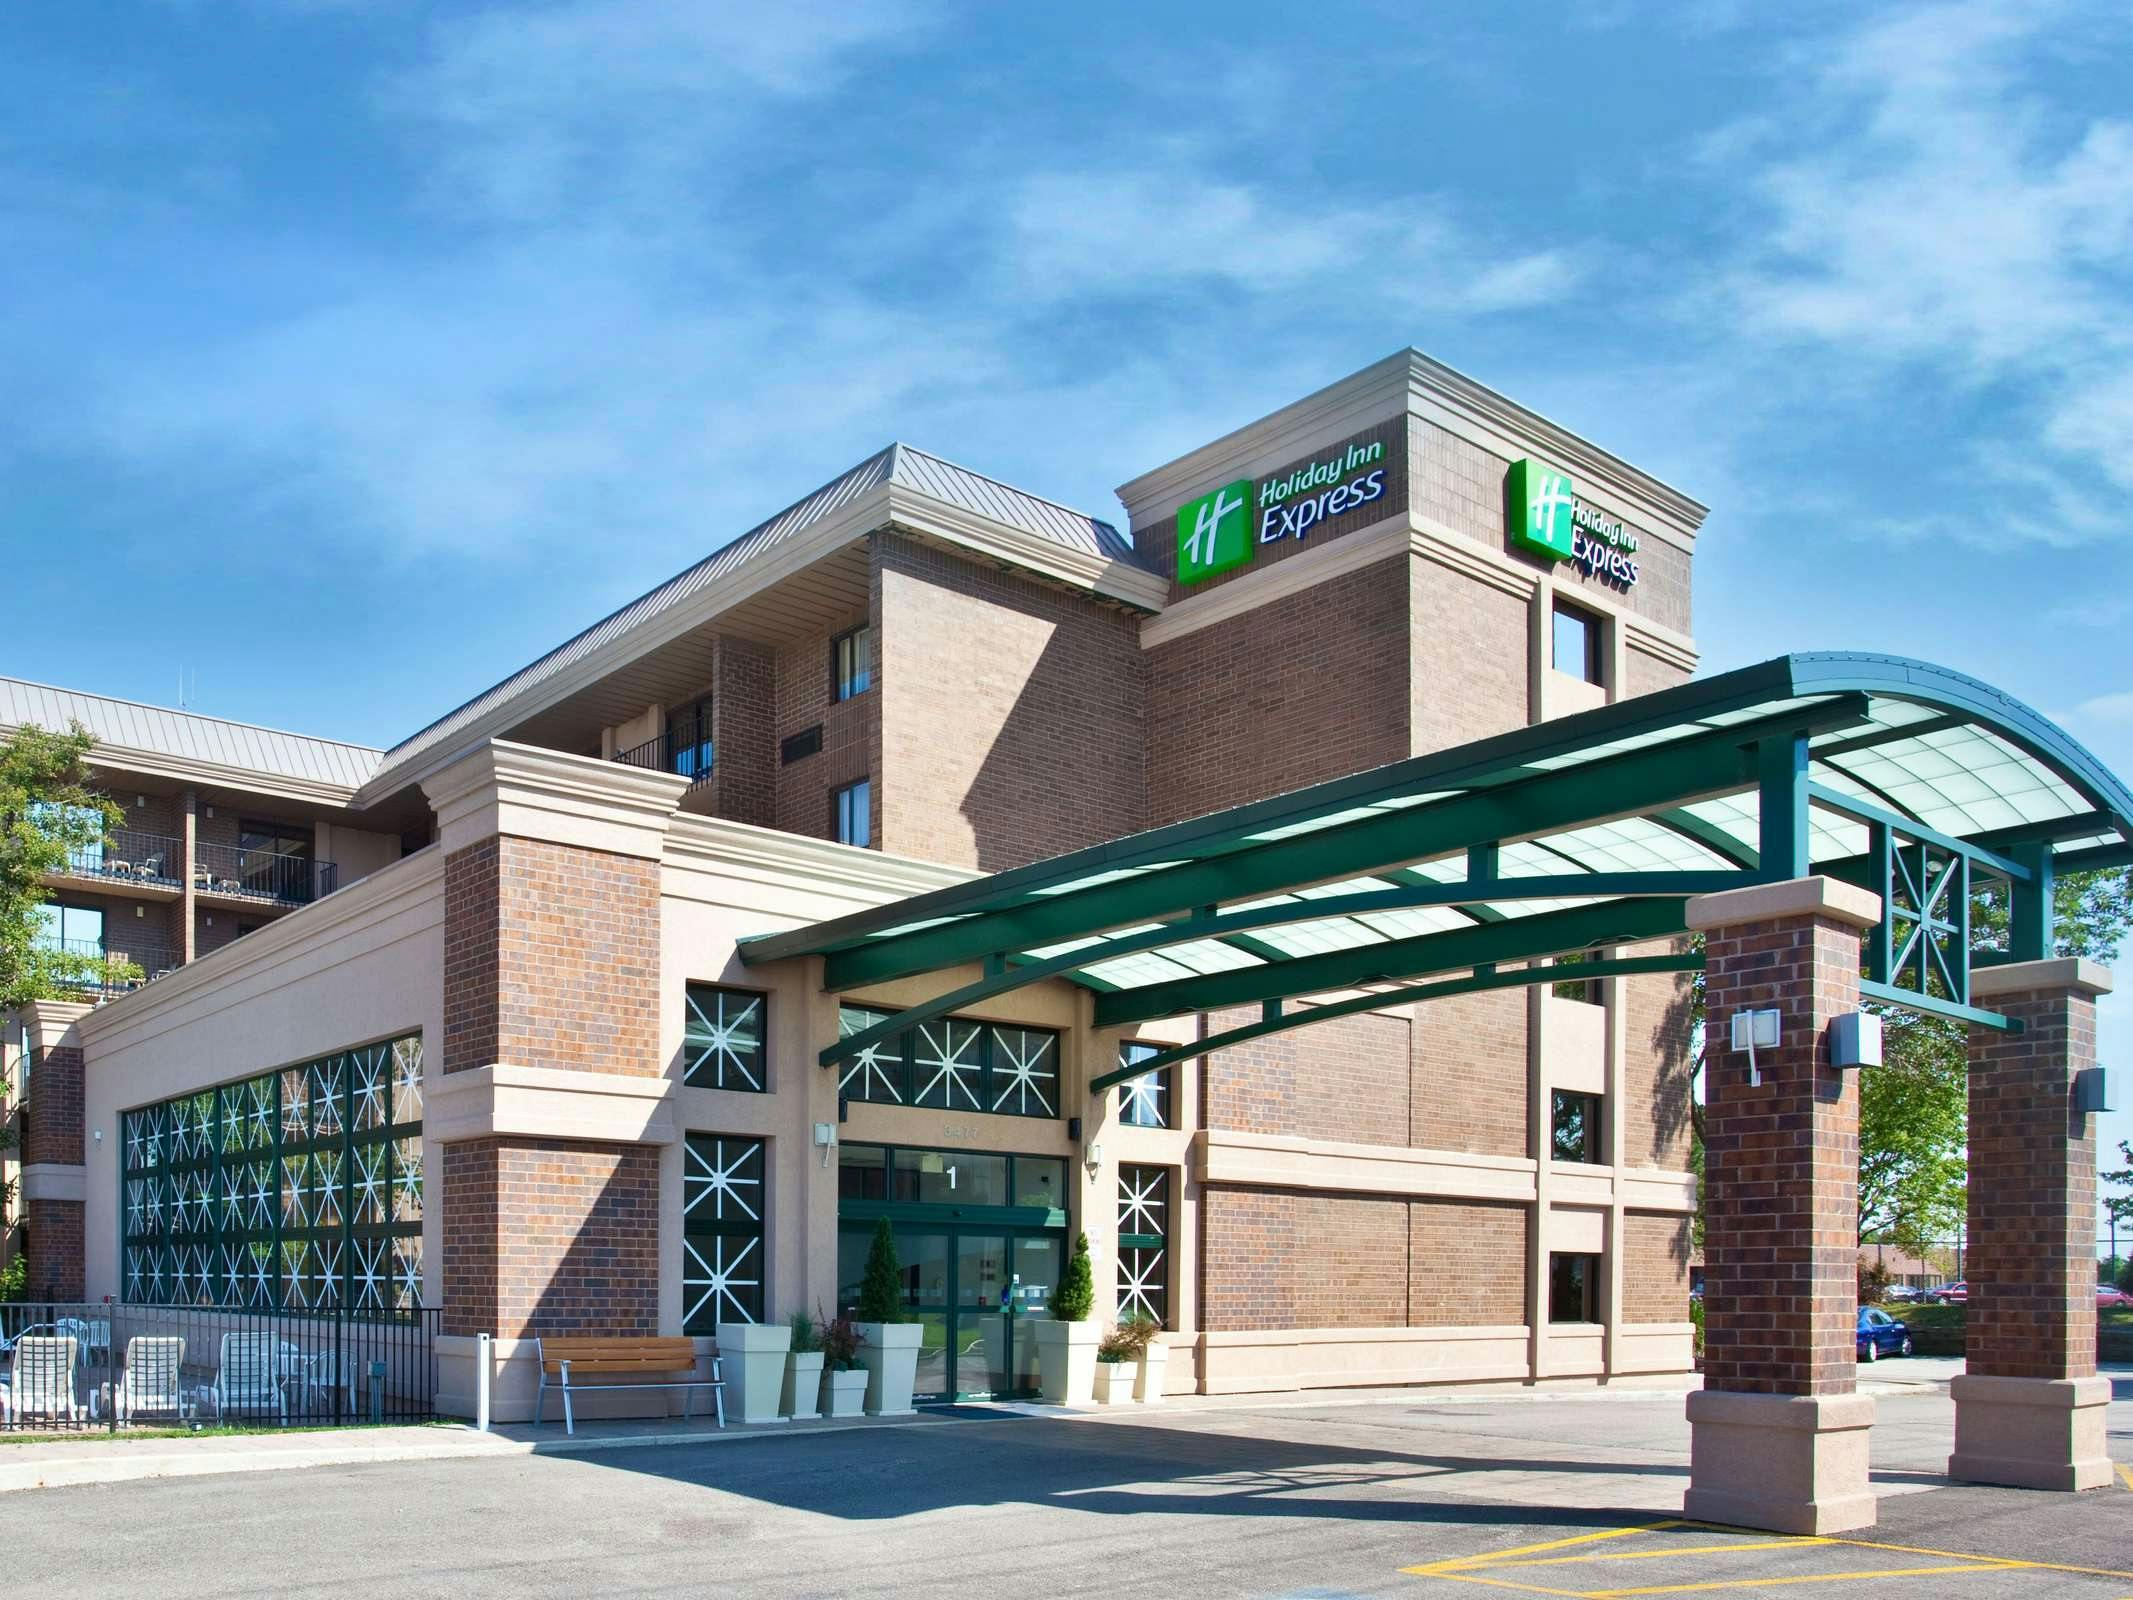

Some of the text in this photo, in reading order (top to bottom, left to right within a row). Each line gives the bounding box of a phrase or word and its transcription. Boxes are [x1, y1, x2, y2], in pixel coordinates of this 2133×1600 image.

[1259, 442, 1381, 507] Holiday Inn
[1260, 470, 1383, 543] Express
[1571, 497, 1639, 552] Holiday Inn
[1572, 525, 1639, 585] Express
[946, 1166, 956, 1189] 1
